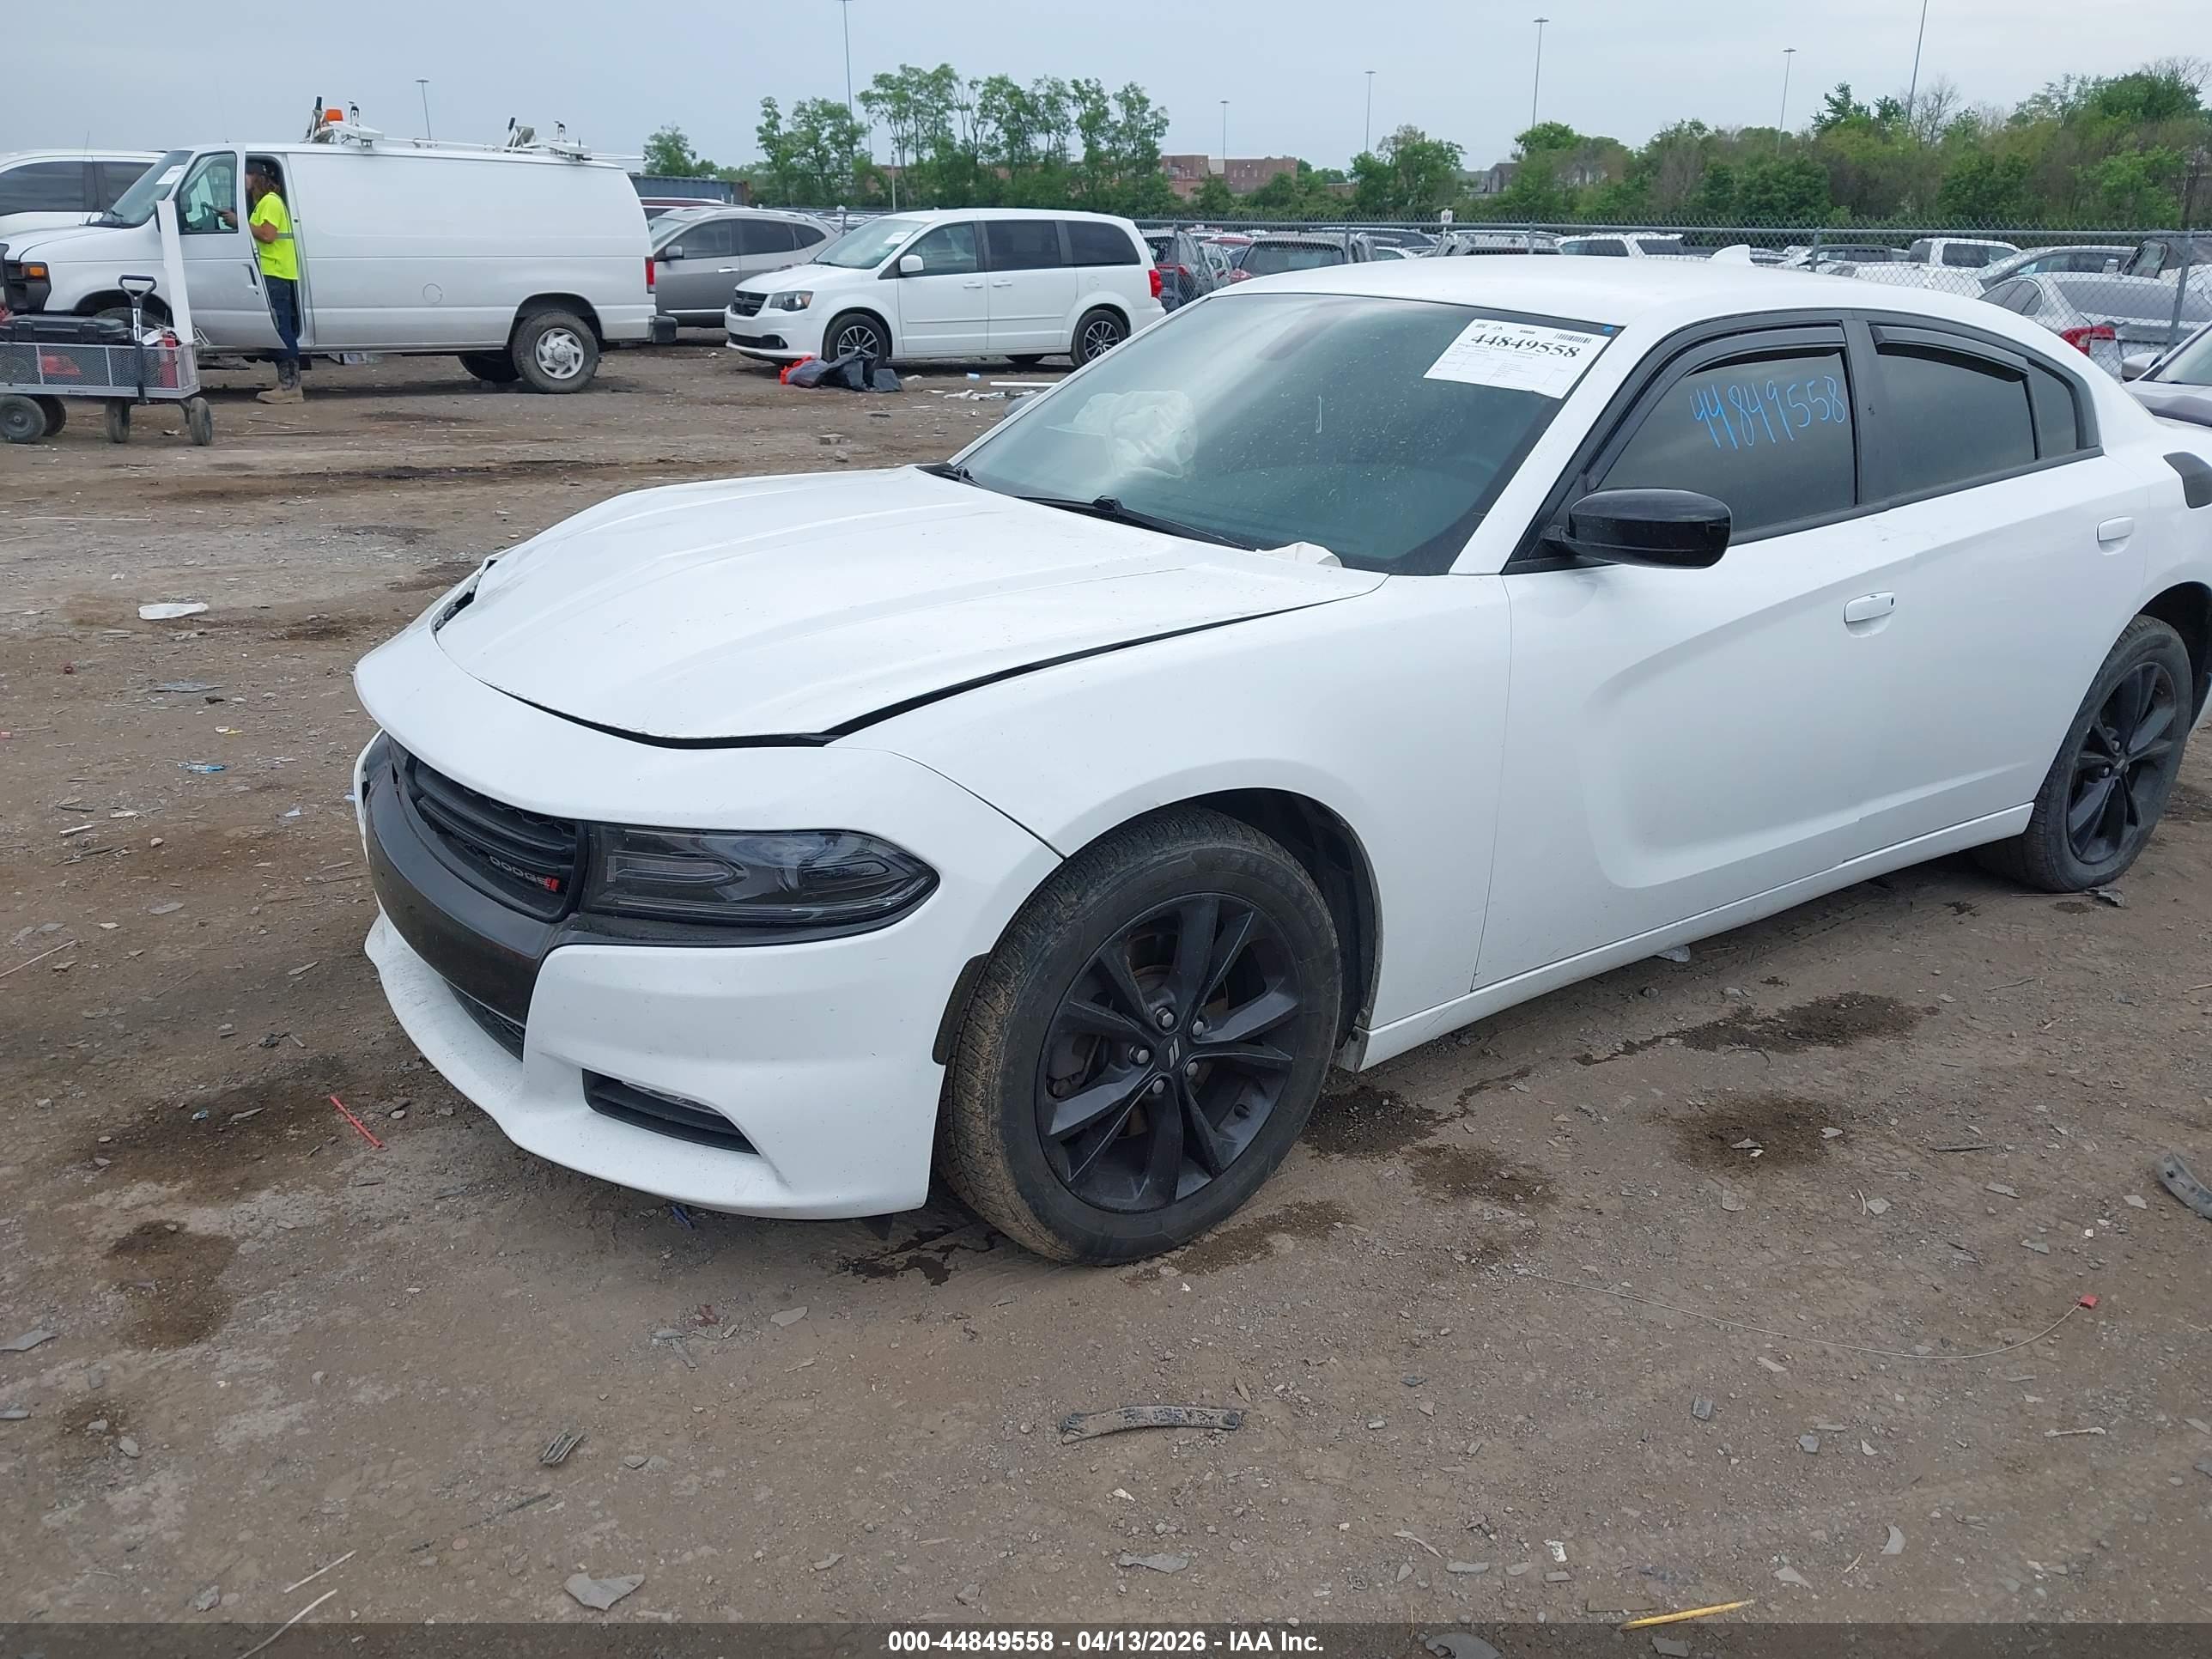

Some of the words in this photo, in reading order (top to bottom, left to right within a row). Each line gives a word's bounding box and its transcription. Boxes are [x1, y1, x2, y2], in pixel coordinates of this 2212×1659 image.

[1471, 333, 1581, 358] 44849558
[1690, 376, 1845, 449] 44849558
[489, 855, 550, 887] DODGE
